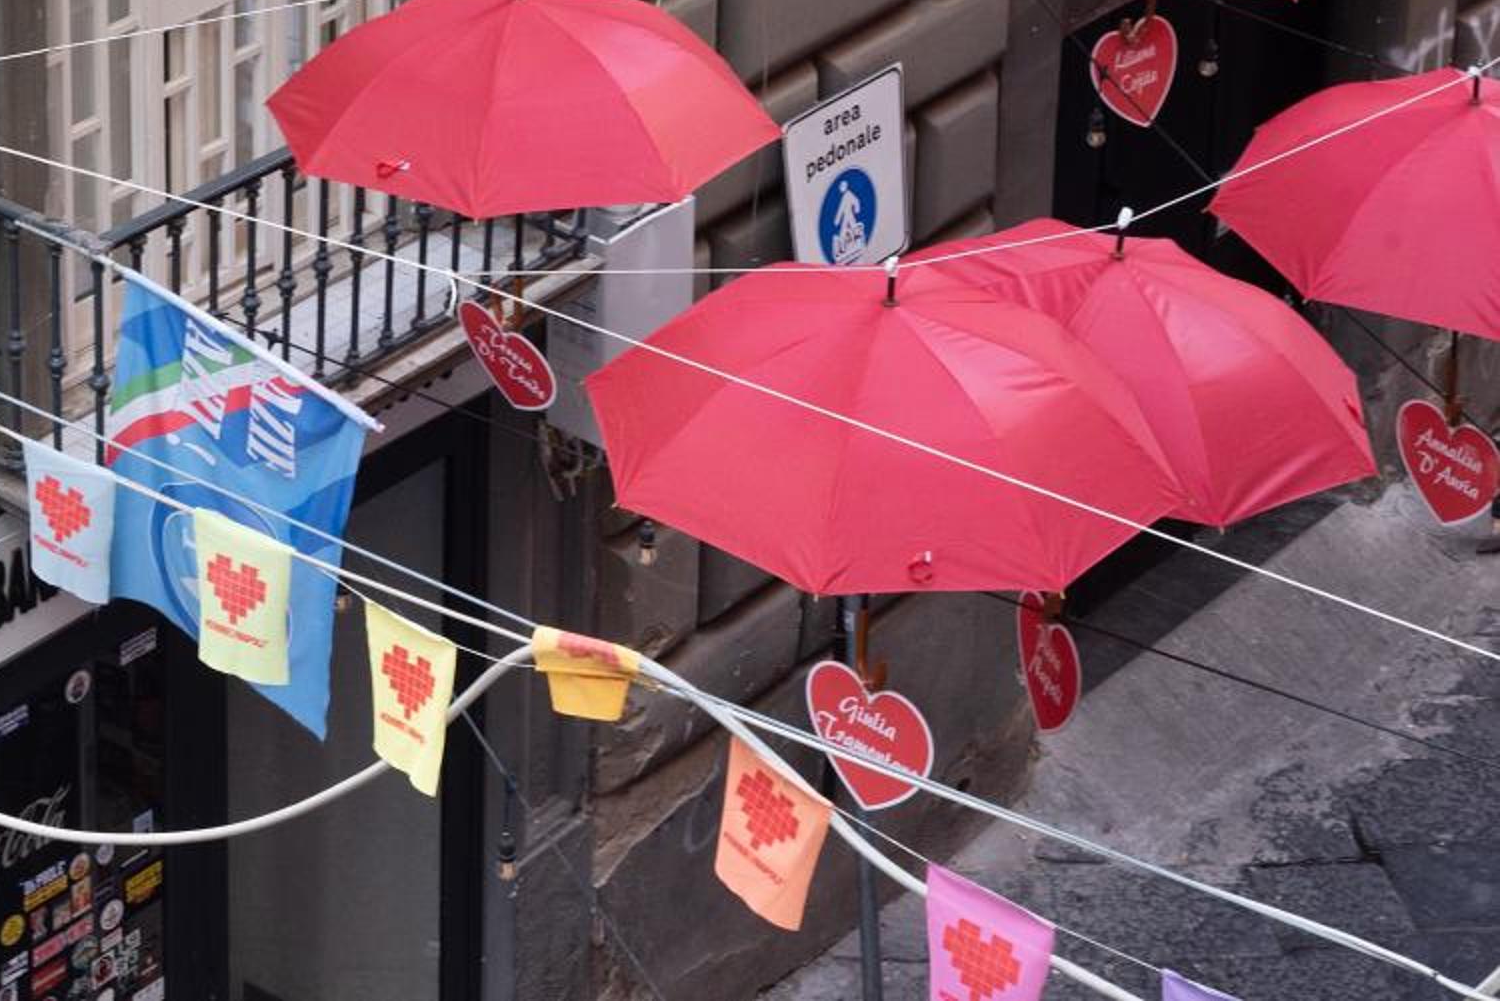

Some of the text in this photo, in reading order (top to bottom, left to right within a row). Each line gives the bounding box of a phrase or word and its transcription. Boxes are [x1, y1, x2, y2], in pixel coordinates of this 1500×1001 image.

[823, 104, 861, 136] area
[806, 124, 881, 183] pedonale
[838, 696, 897, 742] Giulia
